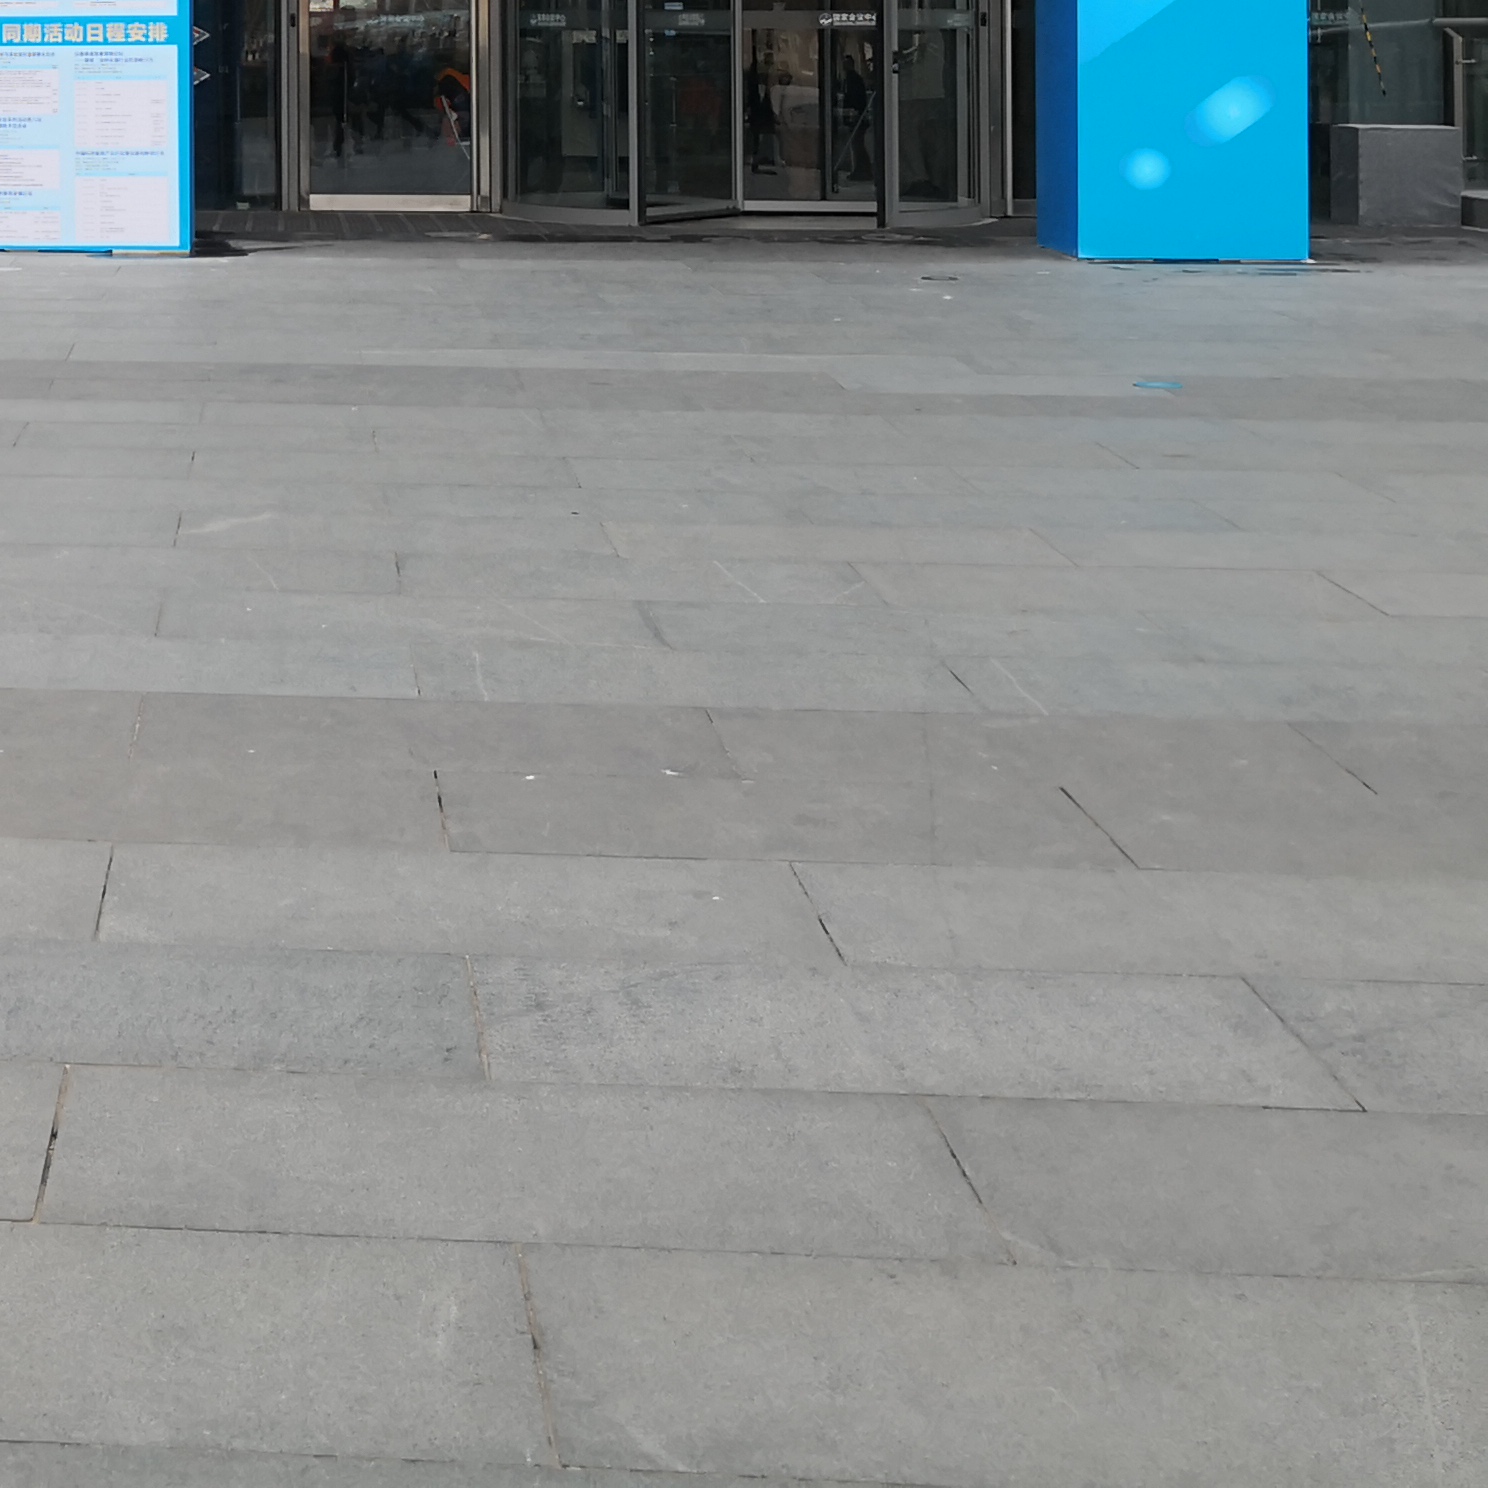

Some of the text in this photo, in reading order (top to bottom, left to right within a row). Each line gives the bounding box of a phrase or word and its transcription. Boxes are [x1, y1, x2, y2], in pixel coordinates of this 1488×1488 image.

[2, 22, 169, 42] 同期活动日程安排
